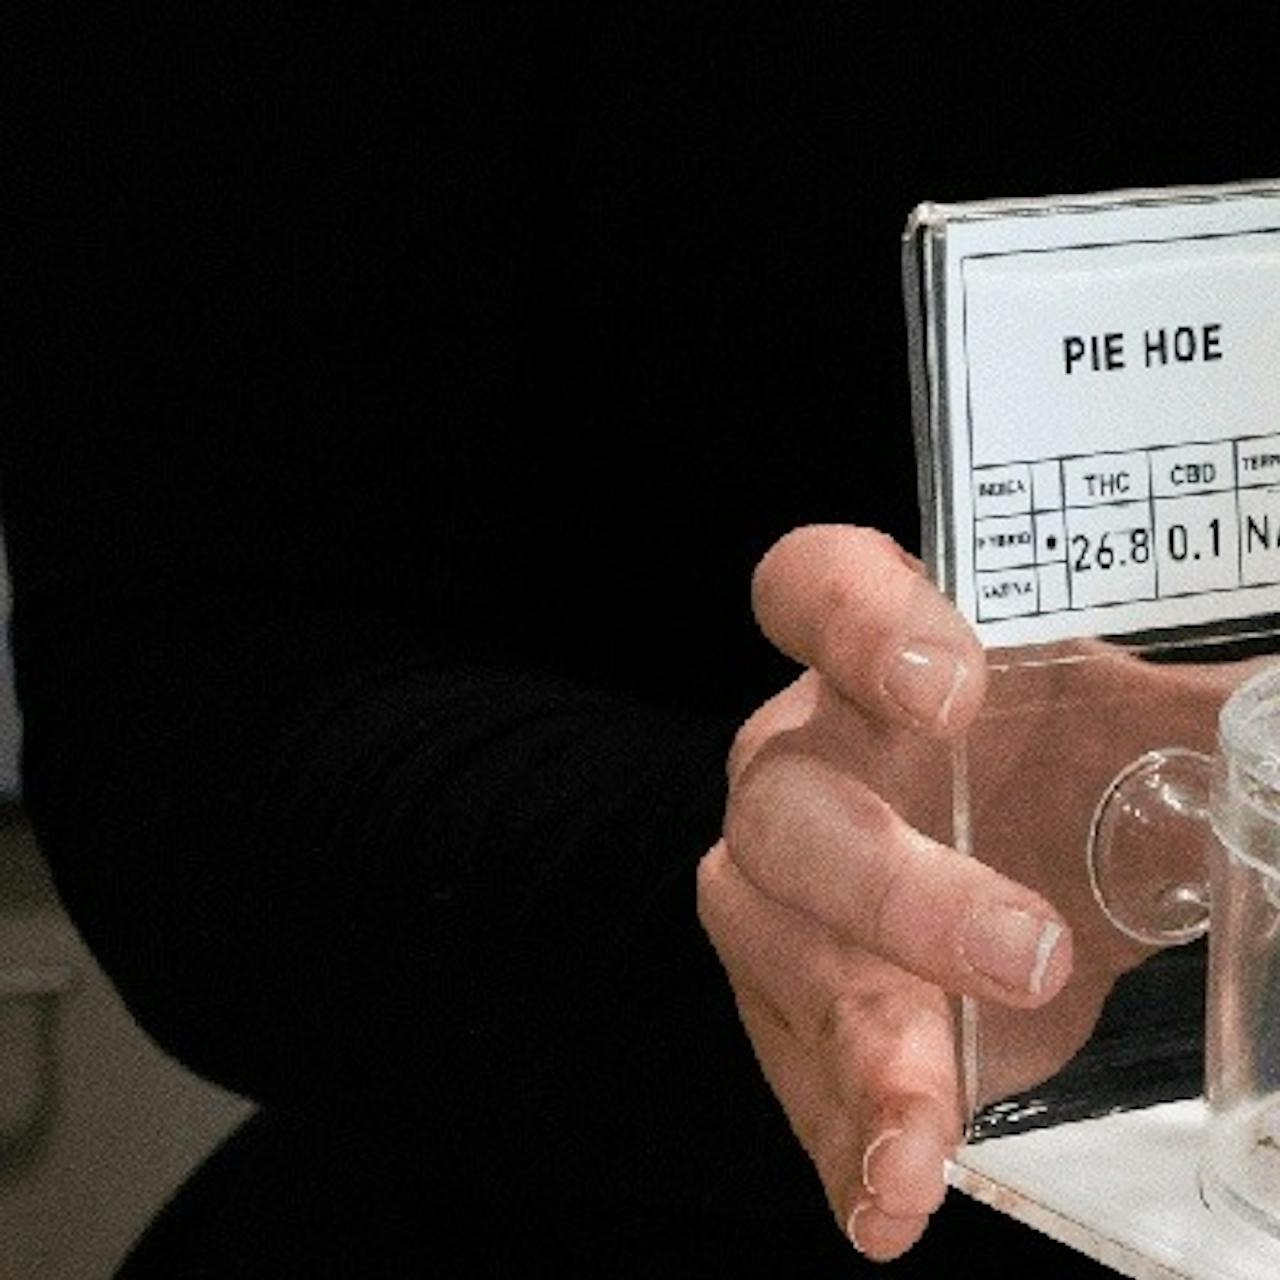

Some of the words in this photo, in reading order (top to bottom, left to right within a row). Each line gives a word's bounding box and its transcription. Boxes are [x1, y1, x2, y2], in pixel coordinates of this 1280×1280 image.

[1063, 332, 1125, 375] PIE
[1143, 322, 1224, 369] HOE
[1082, 471, 1131, 497] THC
[1170, 463, 1217, 486] CBD
[1072, 527, 1150, 573] 26.8
[1168, 517, 1220, 562] 0.1
